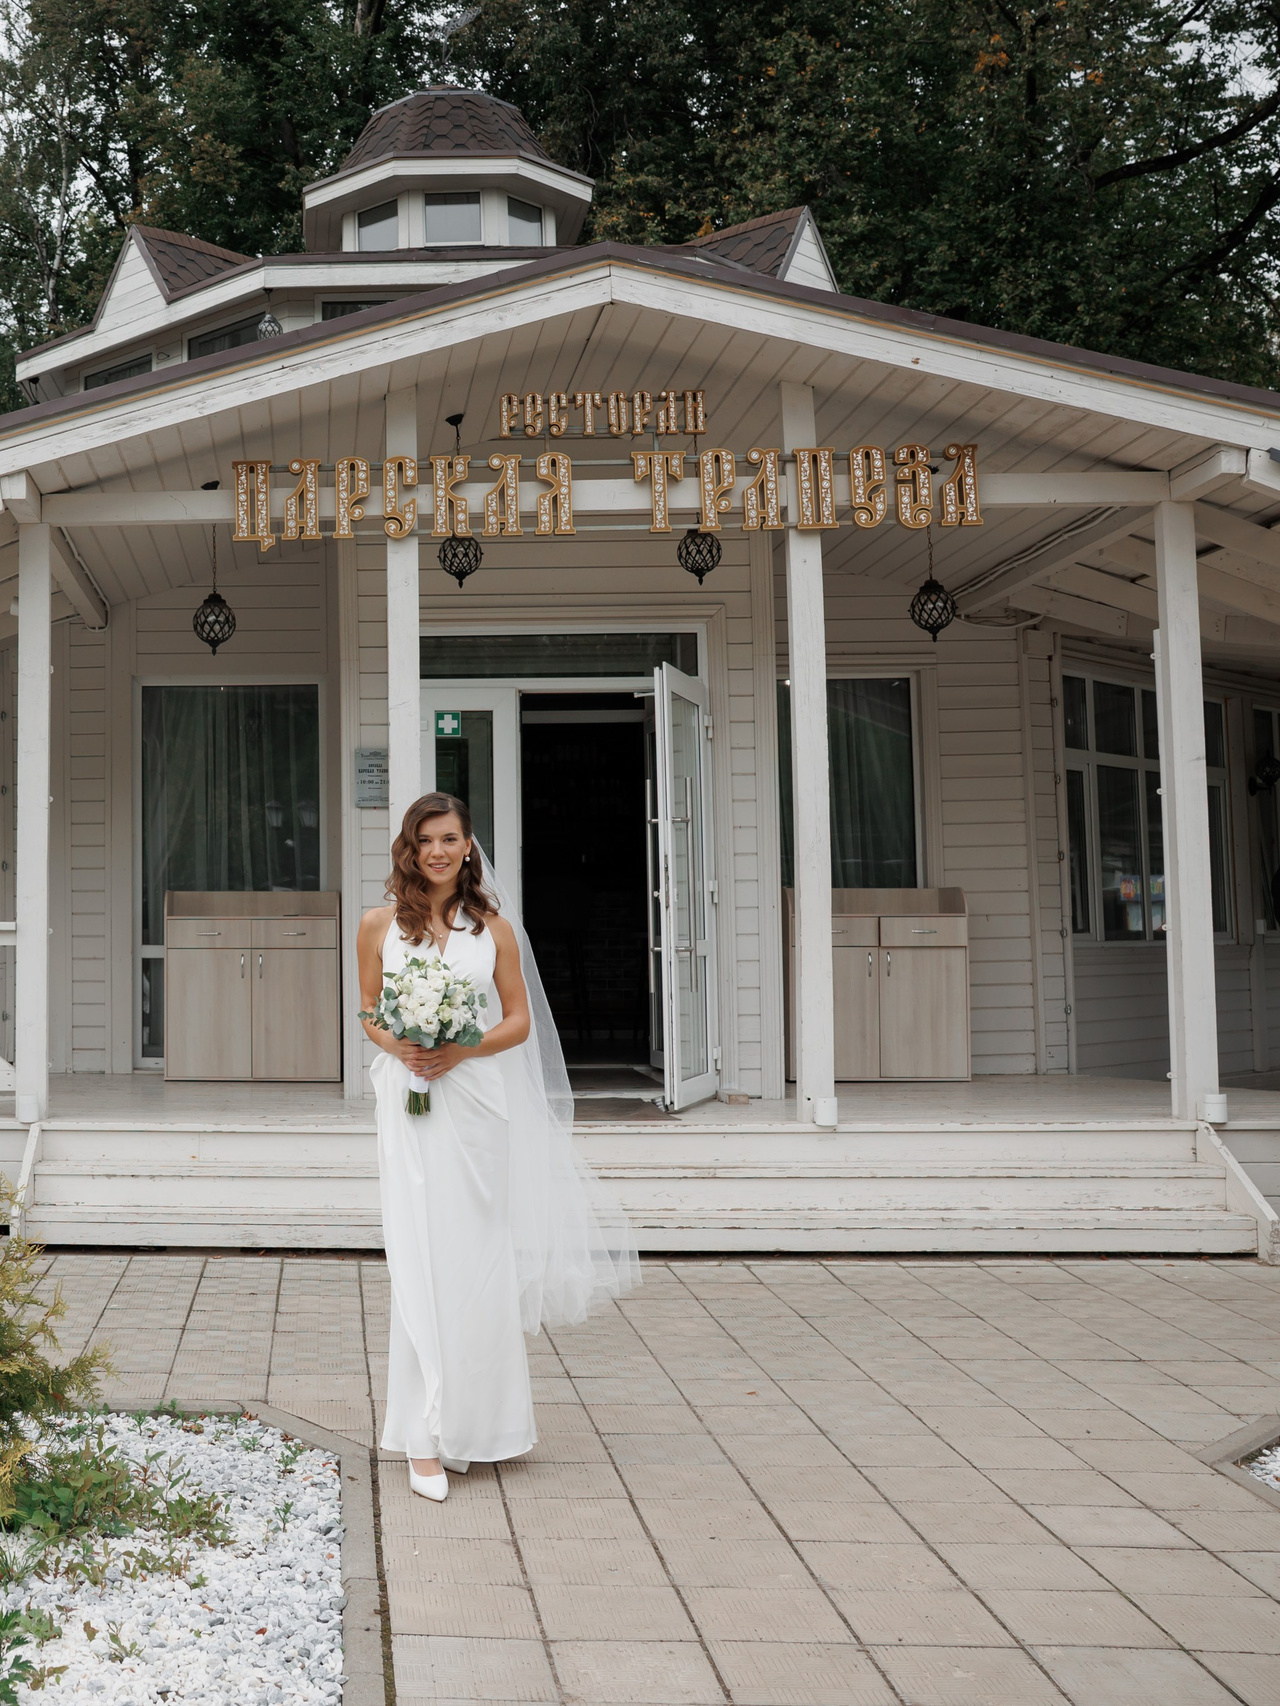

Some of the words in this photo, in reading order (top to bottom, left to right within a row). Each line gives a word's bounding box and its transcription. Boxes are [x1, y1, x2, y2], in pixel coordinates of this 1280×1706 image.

[500, 390, 707, 437] РЕСТОРАН
[232, 452, 576, 552] ЦАРСКАЯ
[631, 443, 984, 533] ТРАПЕЗА
